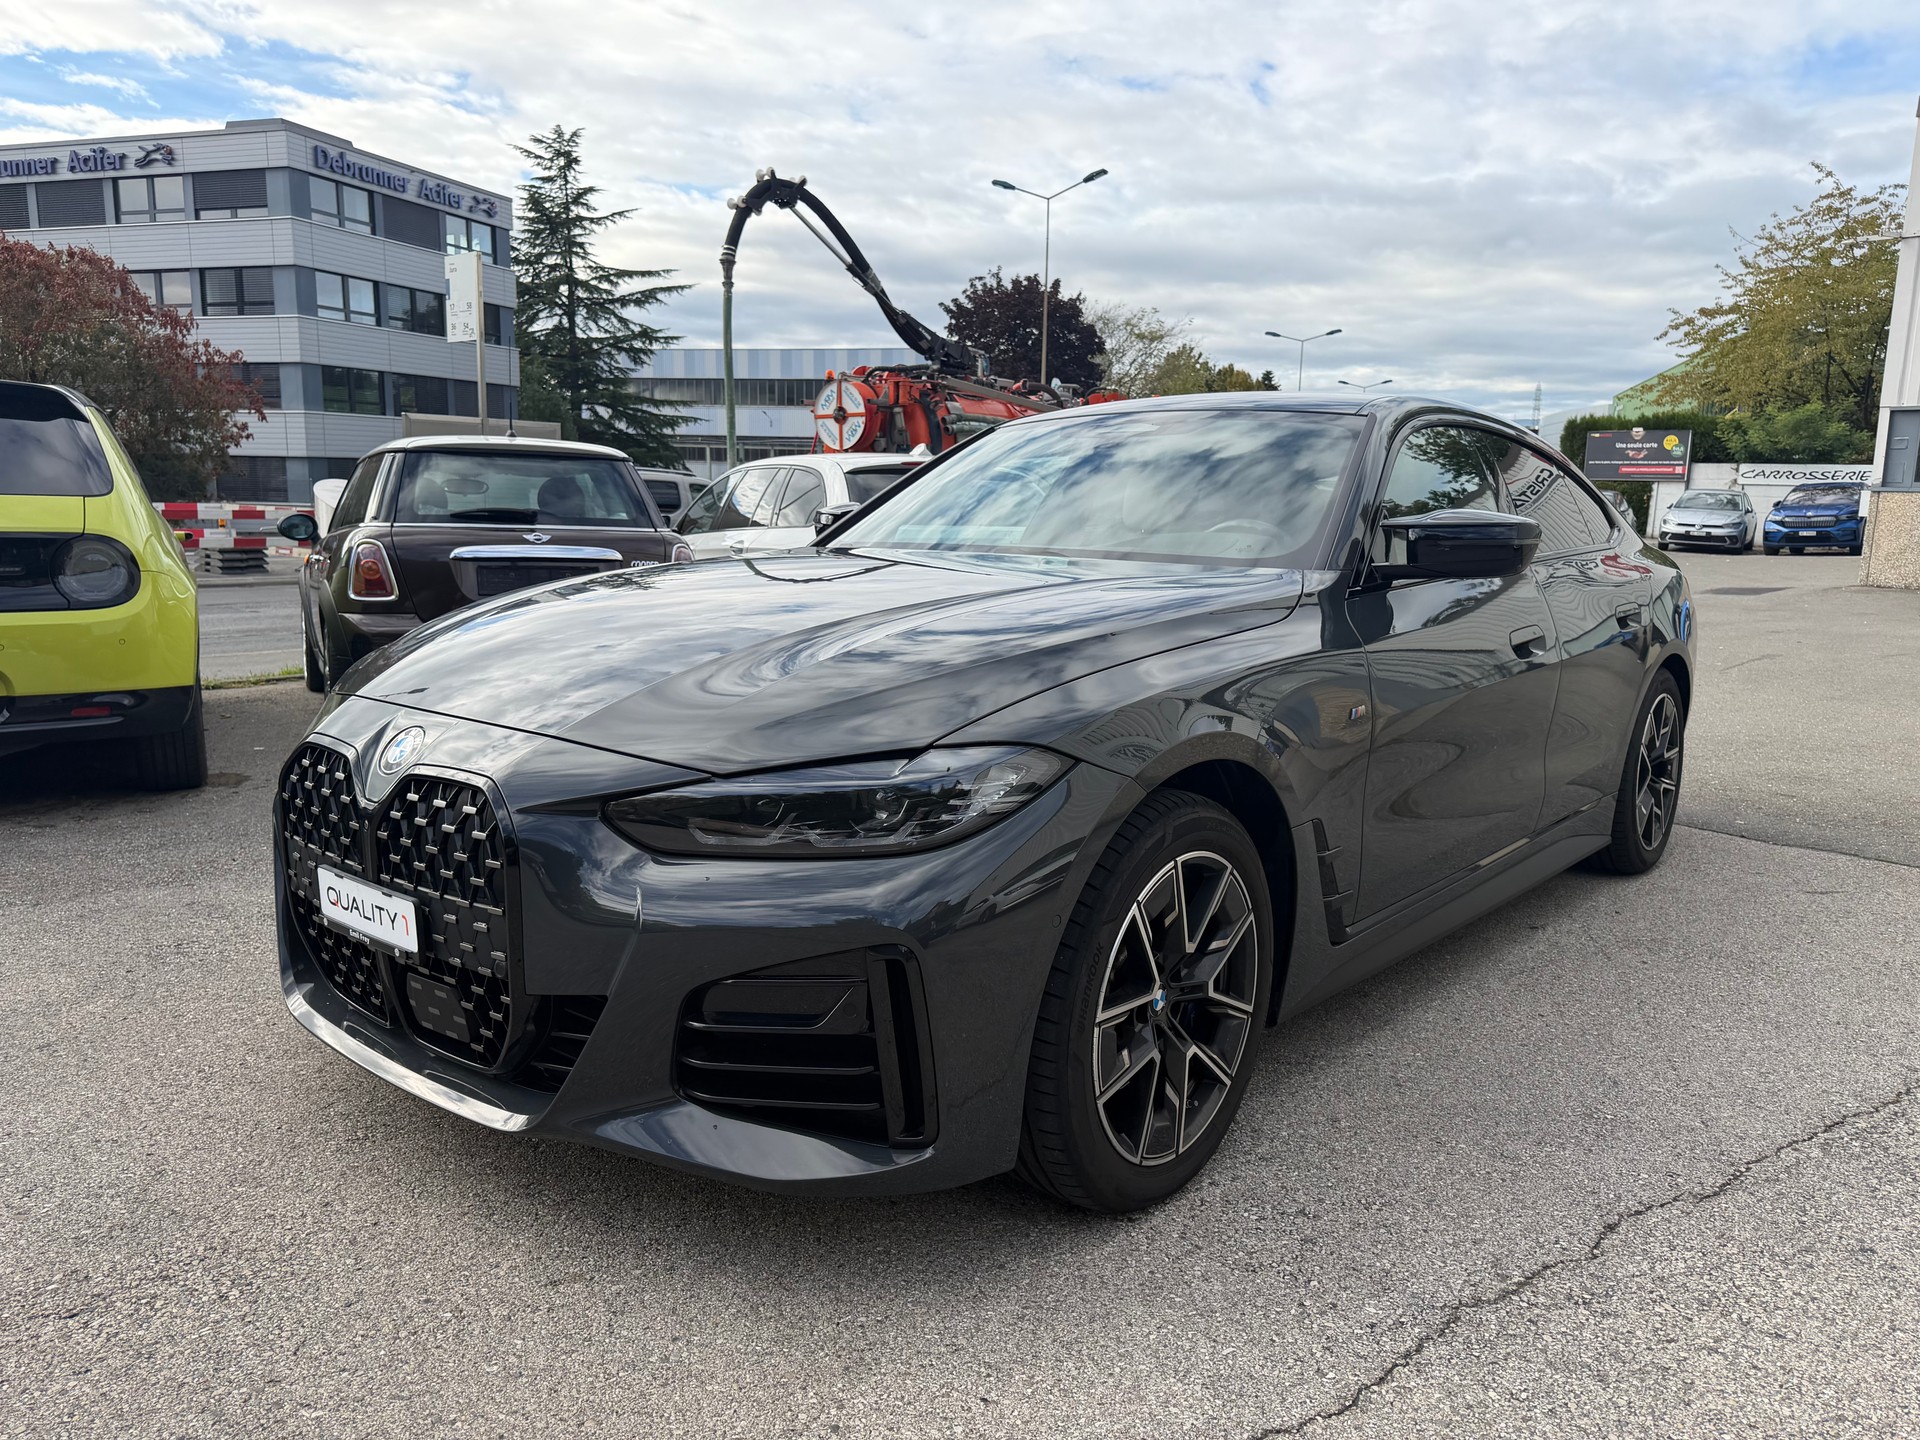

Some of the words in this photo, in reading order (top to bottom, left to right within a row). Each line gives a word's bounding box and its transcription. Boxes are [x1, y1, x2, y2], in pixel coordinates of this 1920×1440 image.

[66, 146, 124, 173] Acifer
[315, 145, 411, 194] Debrunner
[418, 178, 465, 210] Acifer
[1740, 468, 1873, 481] CARROSSERIE
